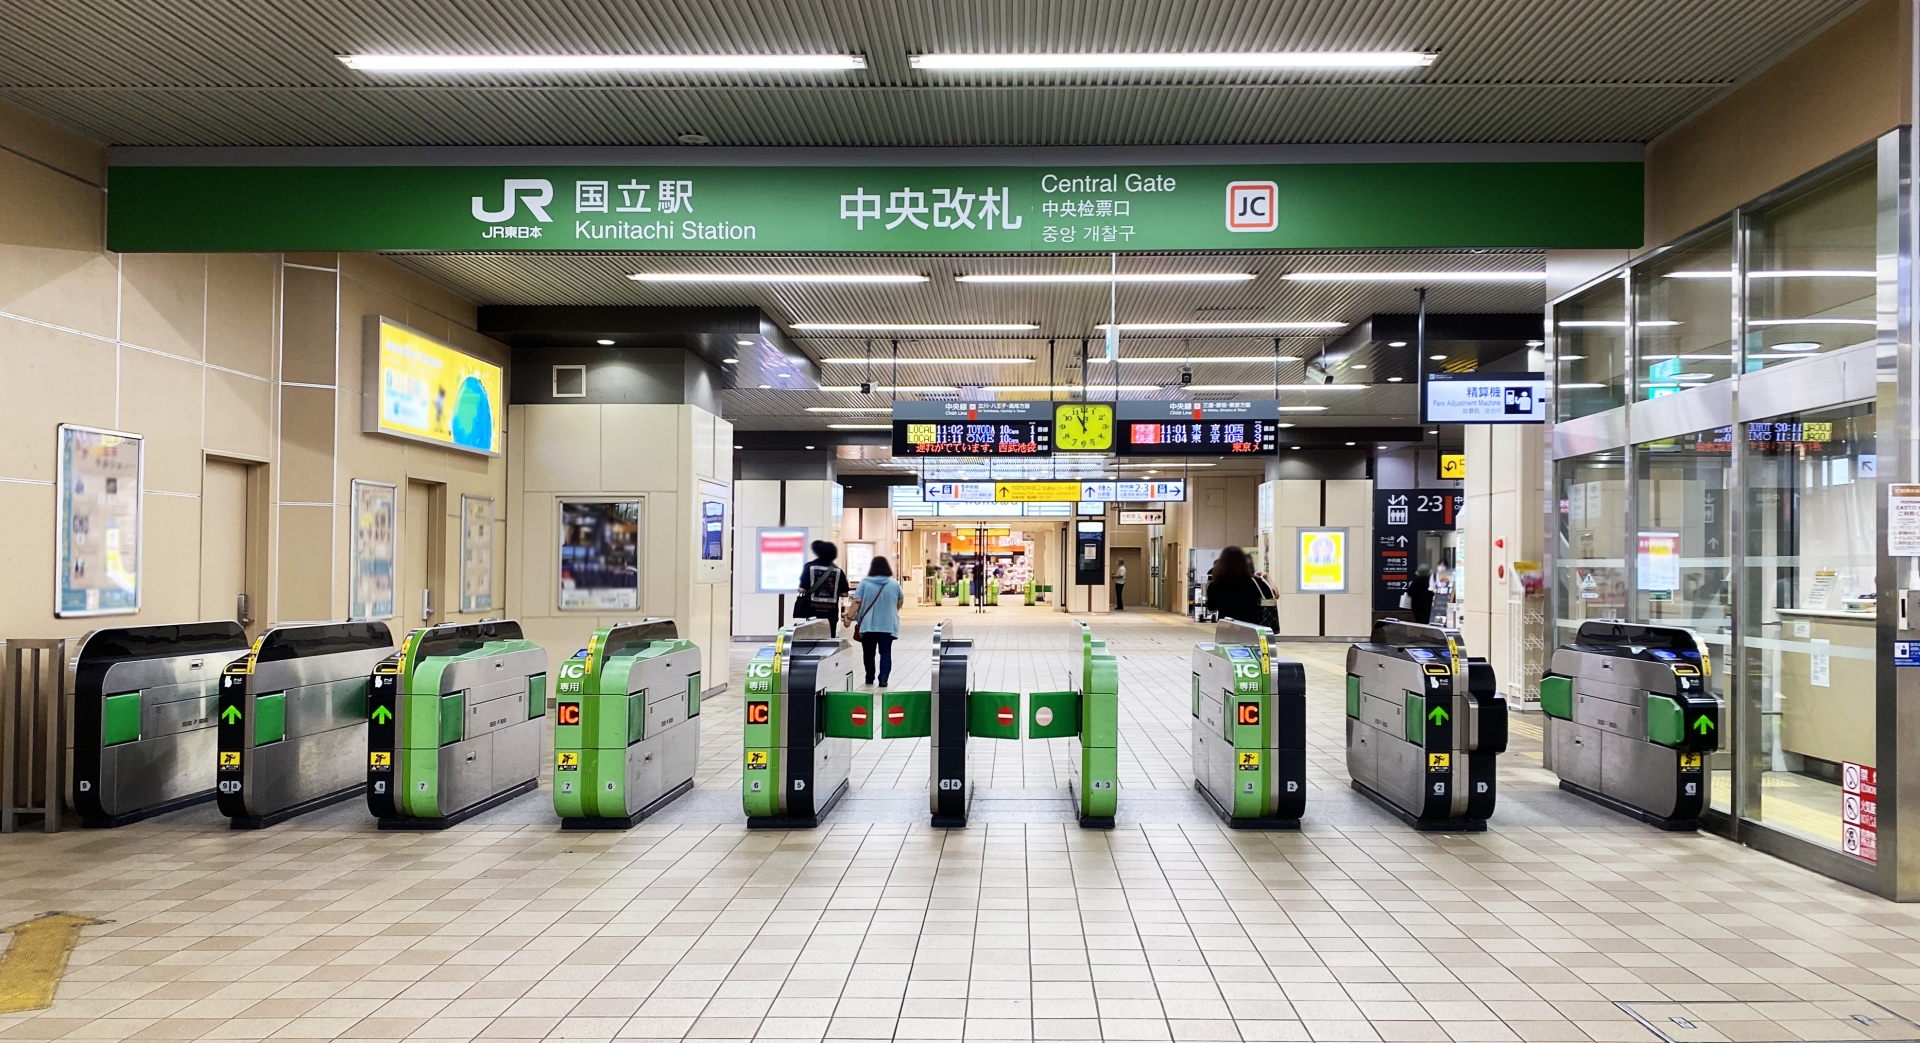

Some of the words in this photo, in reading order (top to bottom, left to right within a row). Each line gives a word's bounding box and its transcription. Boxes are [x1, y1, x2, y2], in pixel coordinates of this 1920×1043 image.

[1041, 174, 1118, 193] Central
[1124, 173, 1176, 193] Gate
[472, 179, 554, 222] JR
[576, 178, 694, 214] 国立駅
[840, 187, 1022, 230] 中央改札
[1042, 199, 1130, 218] 中央检票口
[1238, 196, 1266, 217] JC
[482, 226, 542, 239] JR東日本
[576, 220, 674, 240] Kunitachi
[682, 220, 756, 240] Station
[1042, 225, 1076, 243] 중앙
[1083, 225, 1136, 243] 개찰구
[1466, 386, 1501, 398] 精算機
[908, 425, 935, 433] LOCAL
[937, 425, 963, 434] 11:02
[967, 425, 995, 434] TOYODA
[1161, 424, 1186, 433] 11:01
[1255, 424, 1262, 433] 3
[908, 434, 935, 443] LOCAL
[937, 434, 962, 443] 11:11
[1161, 434, 1187, 443] 11:04
[1255, 434, 1262, 443] 3
[1402, 558, 1407, 566] 3
[560, 664, 584, 678] IC
[749, 664, 772, 678] IC
[1236, 664, 1259, 678] IC
[560, 682, 579, 692] 専用
[749, 681, 768, 691] 専用
[1239, 682, 1259, 691] 専用
[561, 706, 579, 723] IC
[749, 704, 768, 722] IC
[1239, 706, 1258, 723] IC
